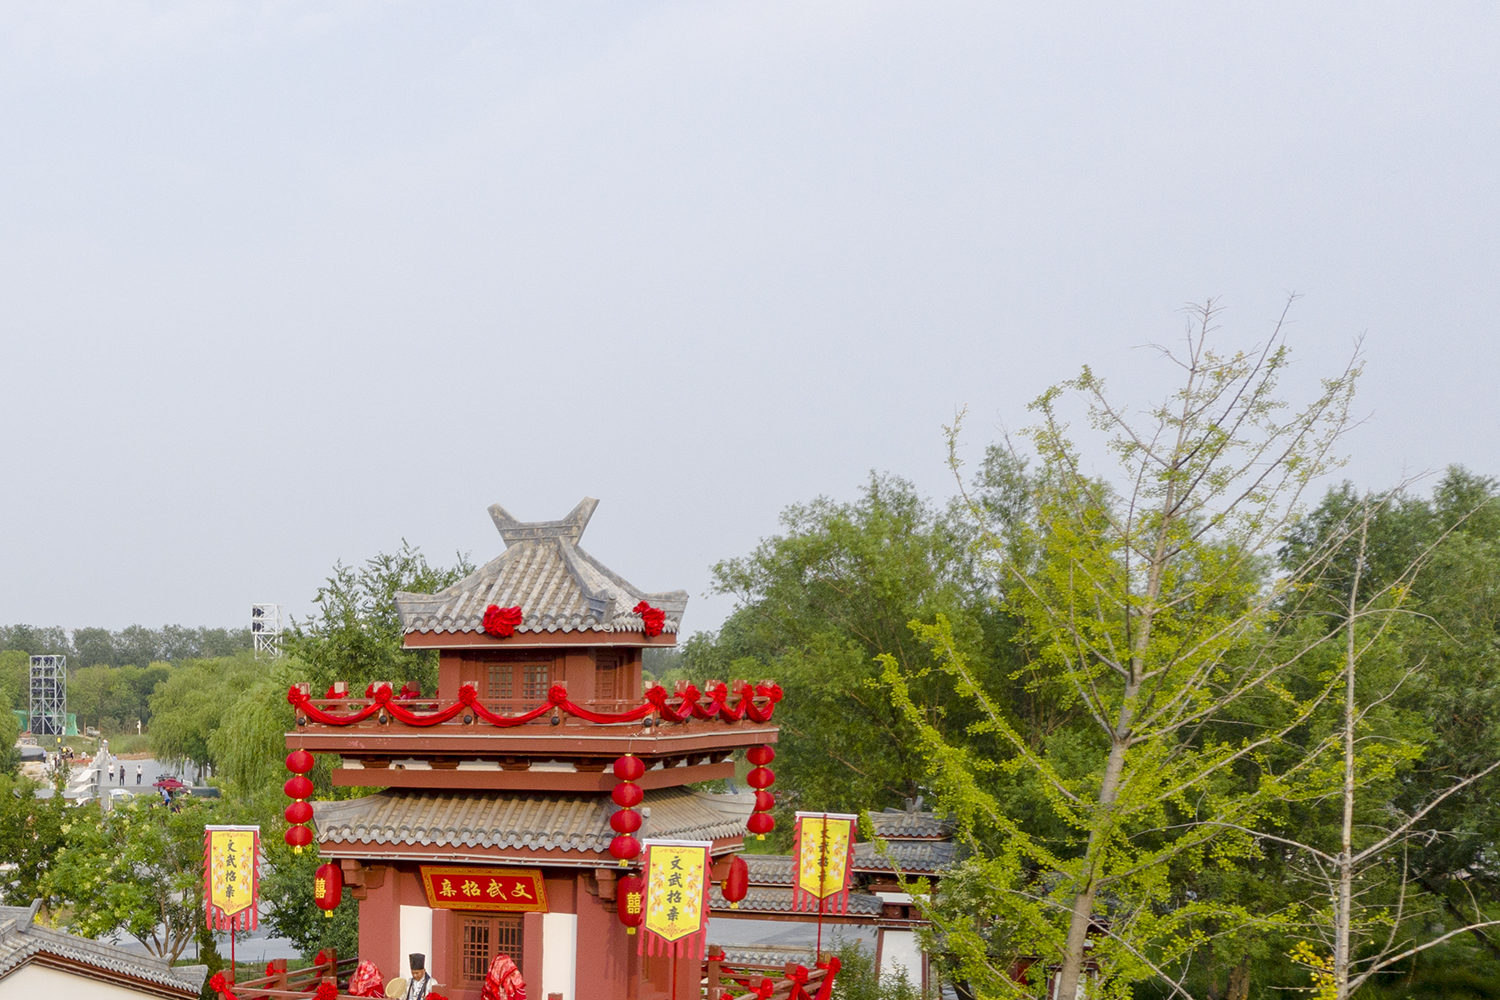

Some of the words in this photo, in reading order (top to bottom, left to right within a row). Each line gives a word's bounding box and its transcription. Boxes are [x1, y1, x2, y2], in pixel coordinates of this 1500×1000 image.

[225, 839, 237, 899] 文武招亲
[666, 855, 684, 922] 文武招亲
